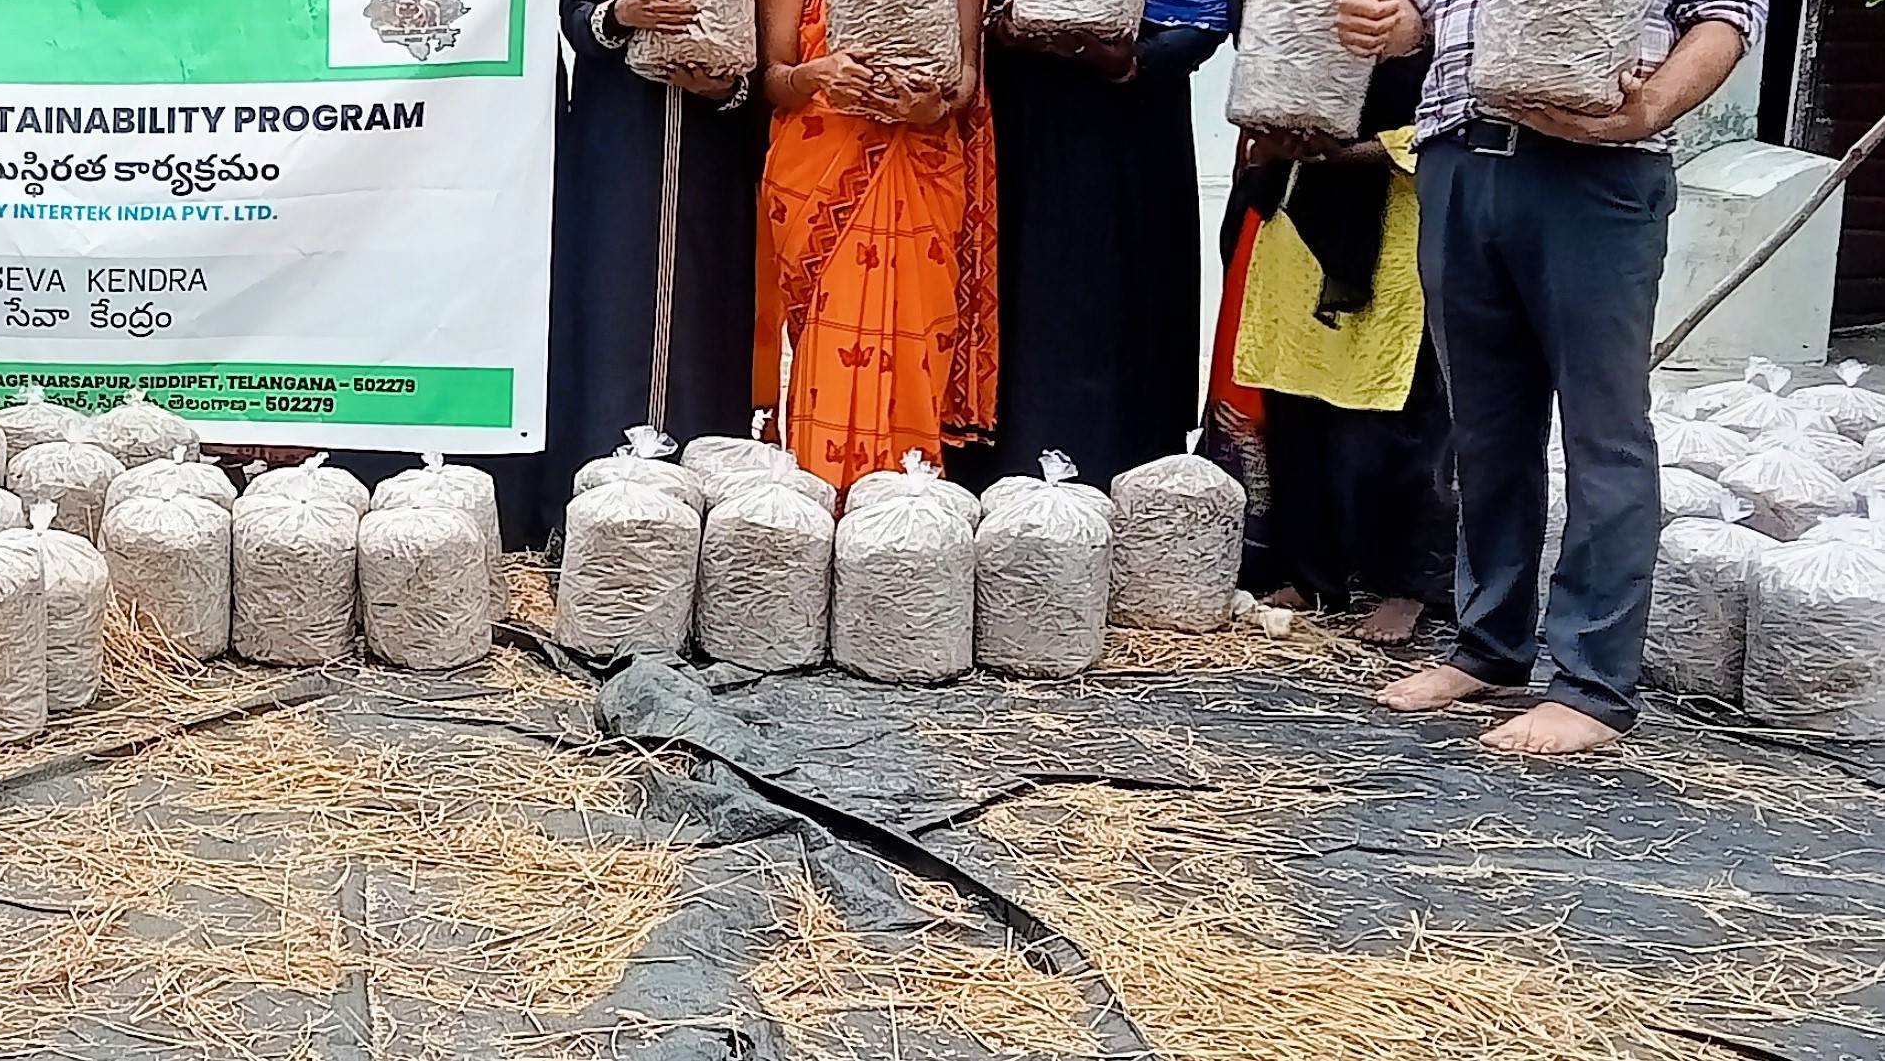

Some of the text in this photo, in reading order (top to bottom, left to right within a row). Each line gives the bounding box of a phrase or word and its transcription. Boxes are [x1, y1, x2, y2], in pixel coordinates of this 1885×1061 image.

[234, 102, 425, 132] PROGRAM
[114, 153, 280, 196] కార్యక్రమం
[14, 204, 111, 221] INTERTEK
[118, 205, 177, 221] INDIA
[182, 205, 229, 221] PVT.
[235, 205, 278, 221] LTD.
[88, 268, 208, 292] KENDRA
[3, 297, 70, 328] సేవా
[90, 298, 173, 338] కేంద్రం
[138, 376, 223, 391] SIDDIPET,
[226, 376, 336, 392] TELANGANA
[353, 377, 416, 393] 502279
[265, 396, 334, 413] 502279
